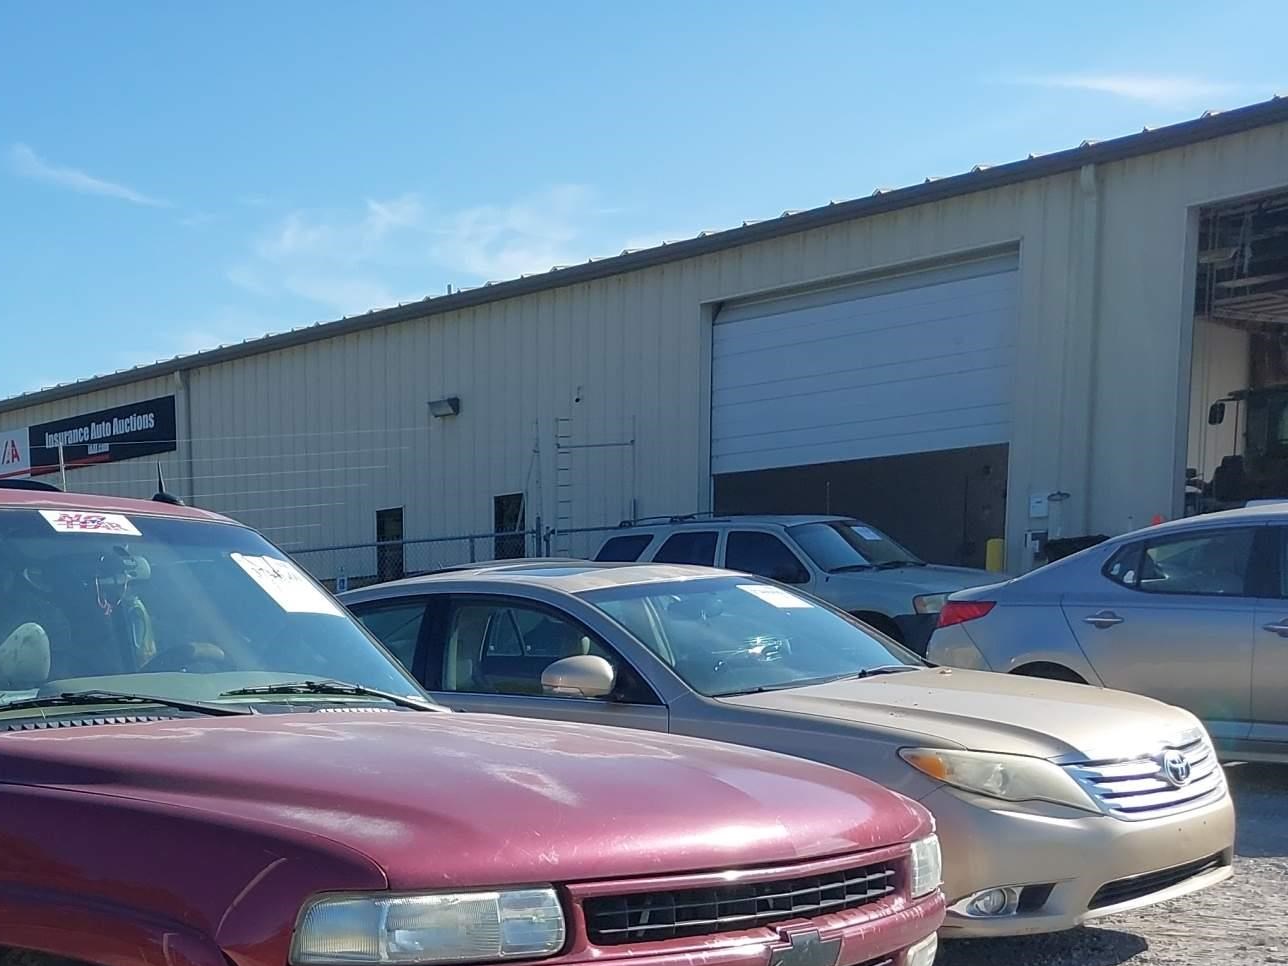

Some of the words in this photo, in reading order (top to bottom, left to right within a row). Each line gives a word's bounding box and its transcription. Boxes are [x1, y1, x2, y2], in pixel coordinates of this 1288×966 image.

[45, 426, 90, 449] Insurance
[91, 420, 112, 439] Auto
[113, 413, 155, 434] Auctions
